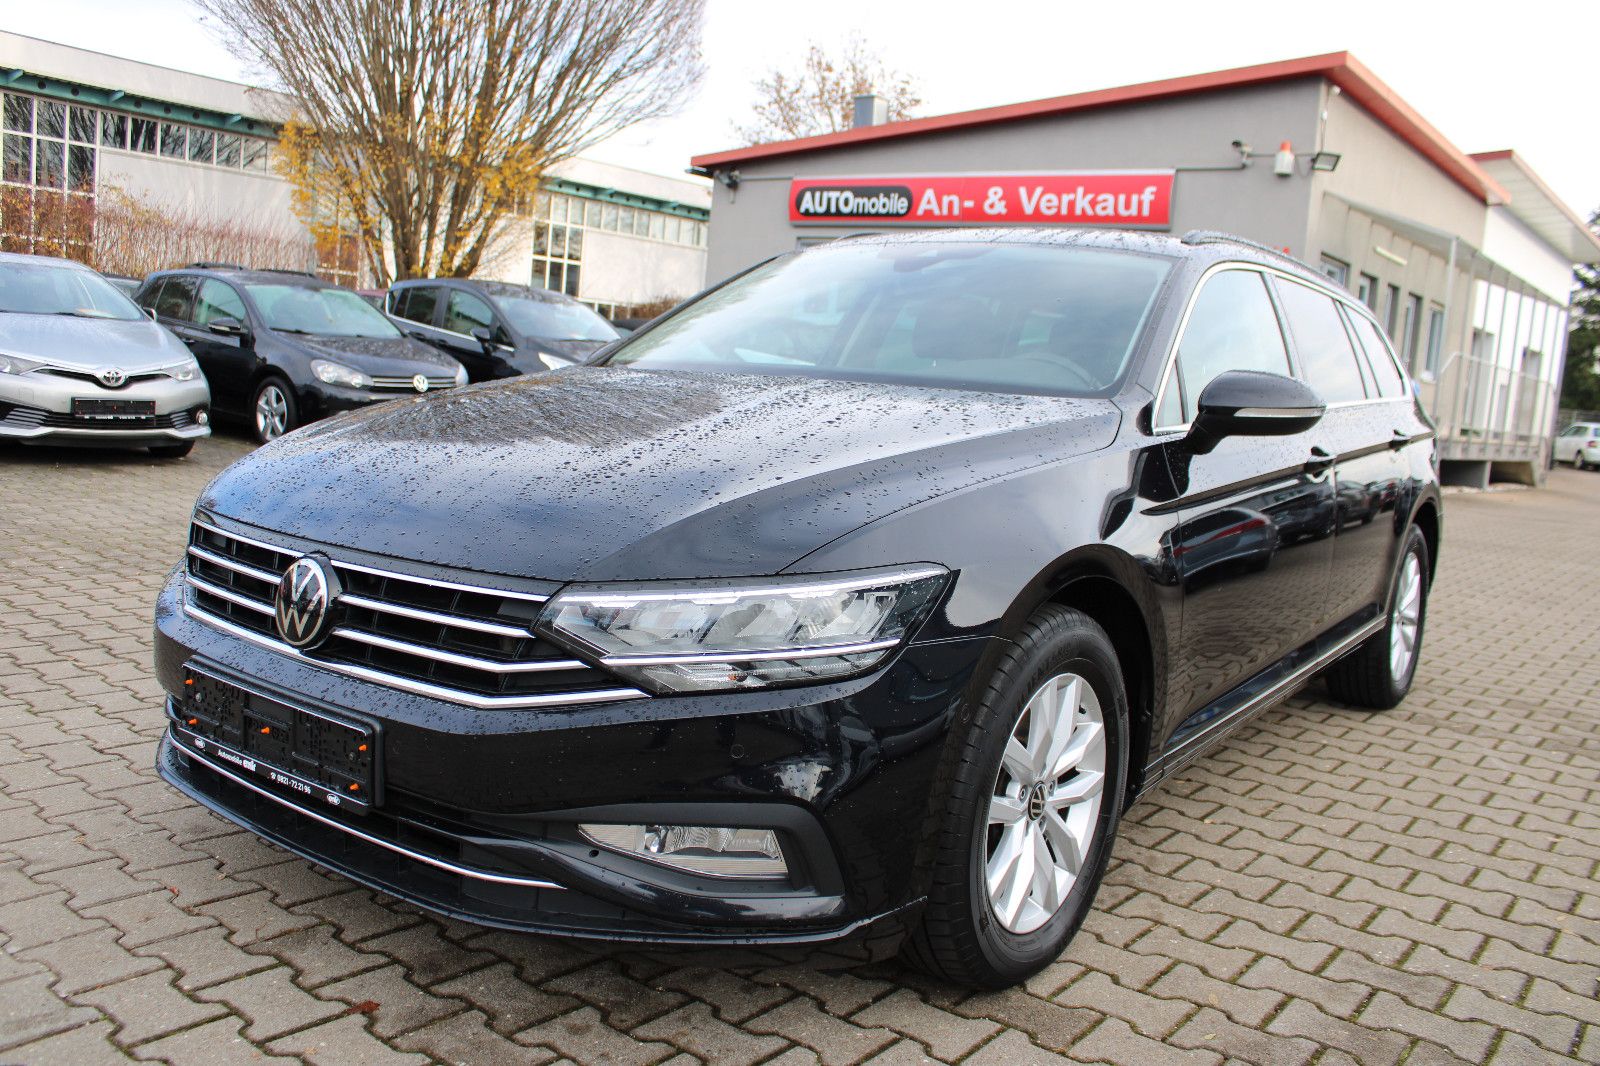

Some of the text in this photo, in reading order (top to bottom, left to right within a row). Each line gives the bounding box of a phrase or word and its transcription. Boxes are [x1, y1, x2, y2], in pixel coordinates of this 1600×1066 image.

[800, 186, 1157, 217] AUTOmobile An- & Verkauf
